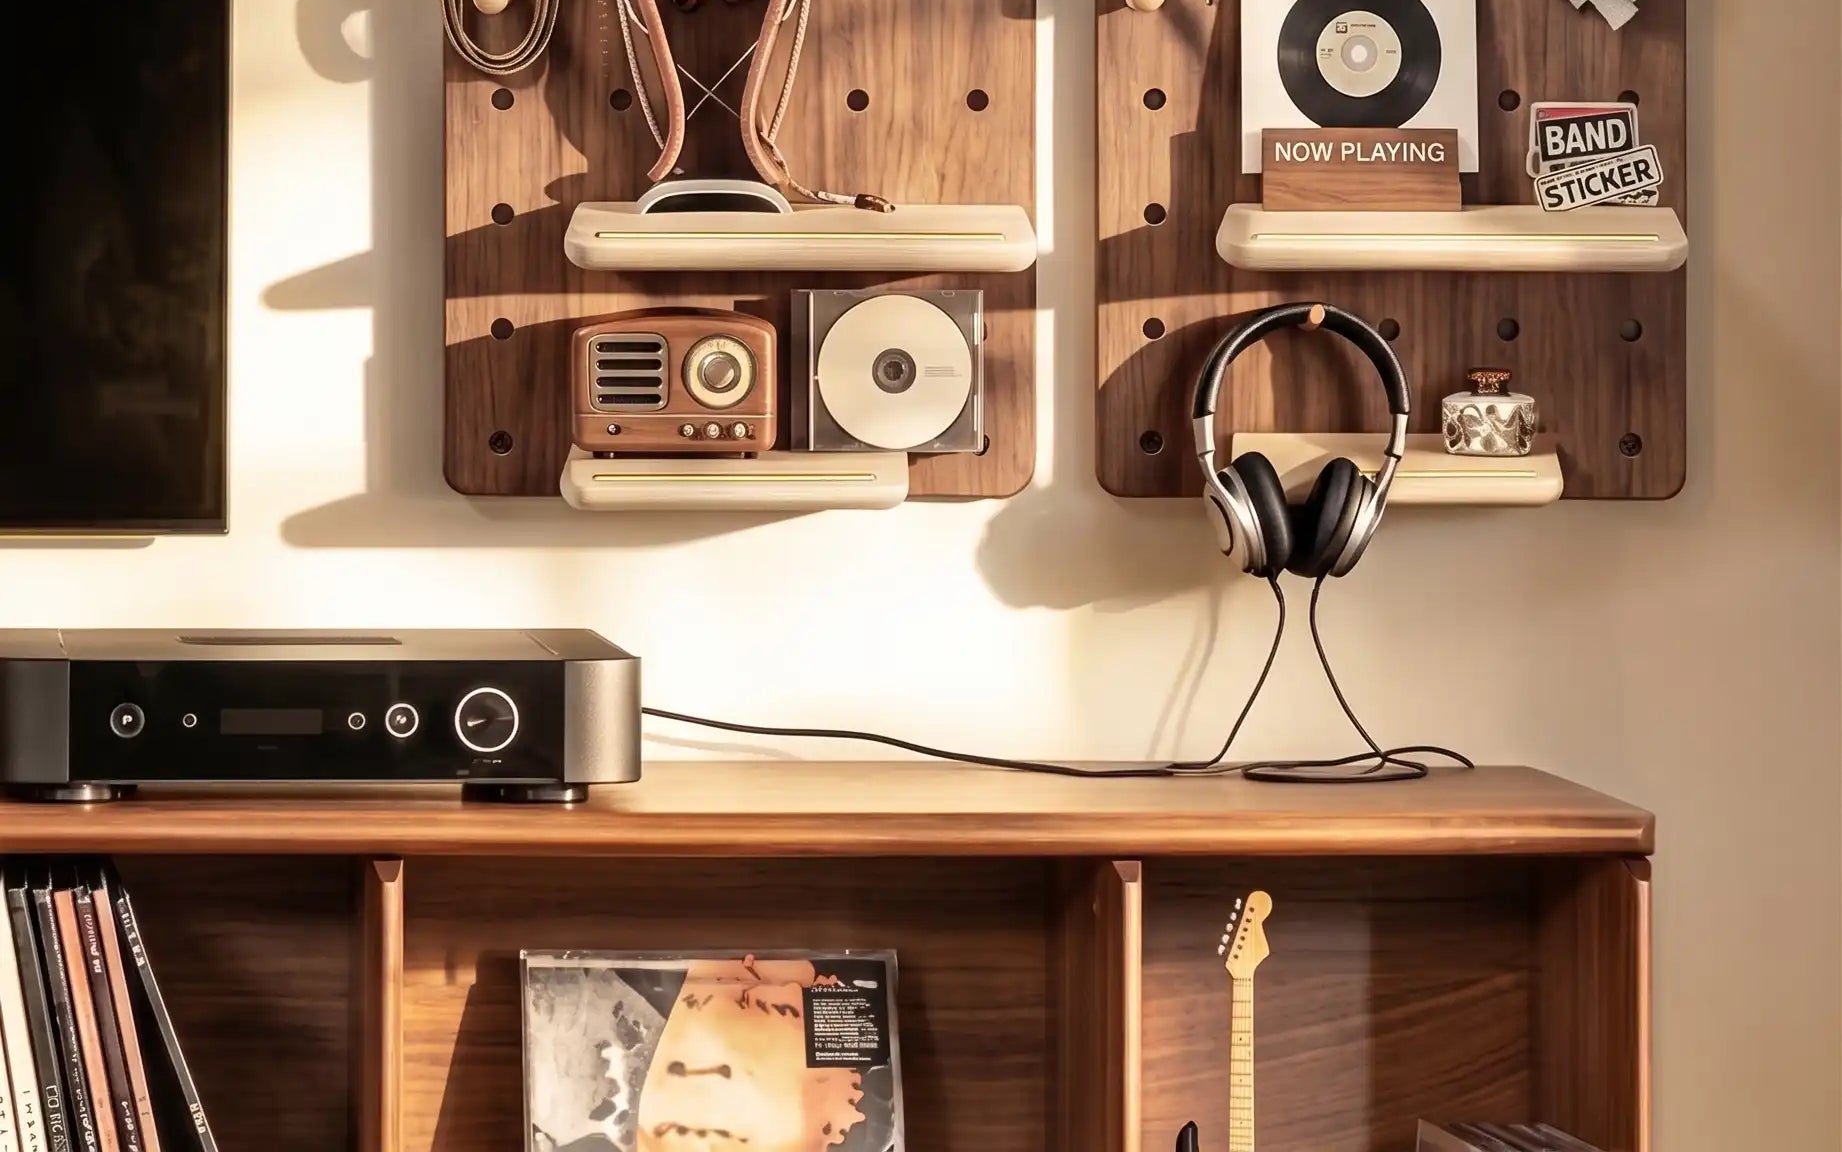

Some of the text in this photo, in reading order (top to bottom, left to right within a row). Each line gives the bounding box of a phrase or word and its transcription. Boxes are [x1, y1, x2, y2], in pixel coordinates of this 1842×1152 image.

[1275, 141, 1445, 162] NOW PLAYING
[1545, 118, 1627, 156] BAND
[1544, 158, 1655, 208] STICKER
